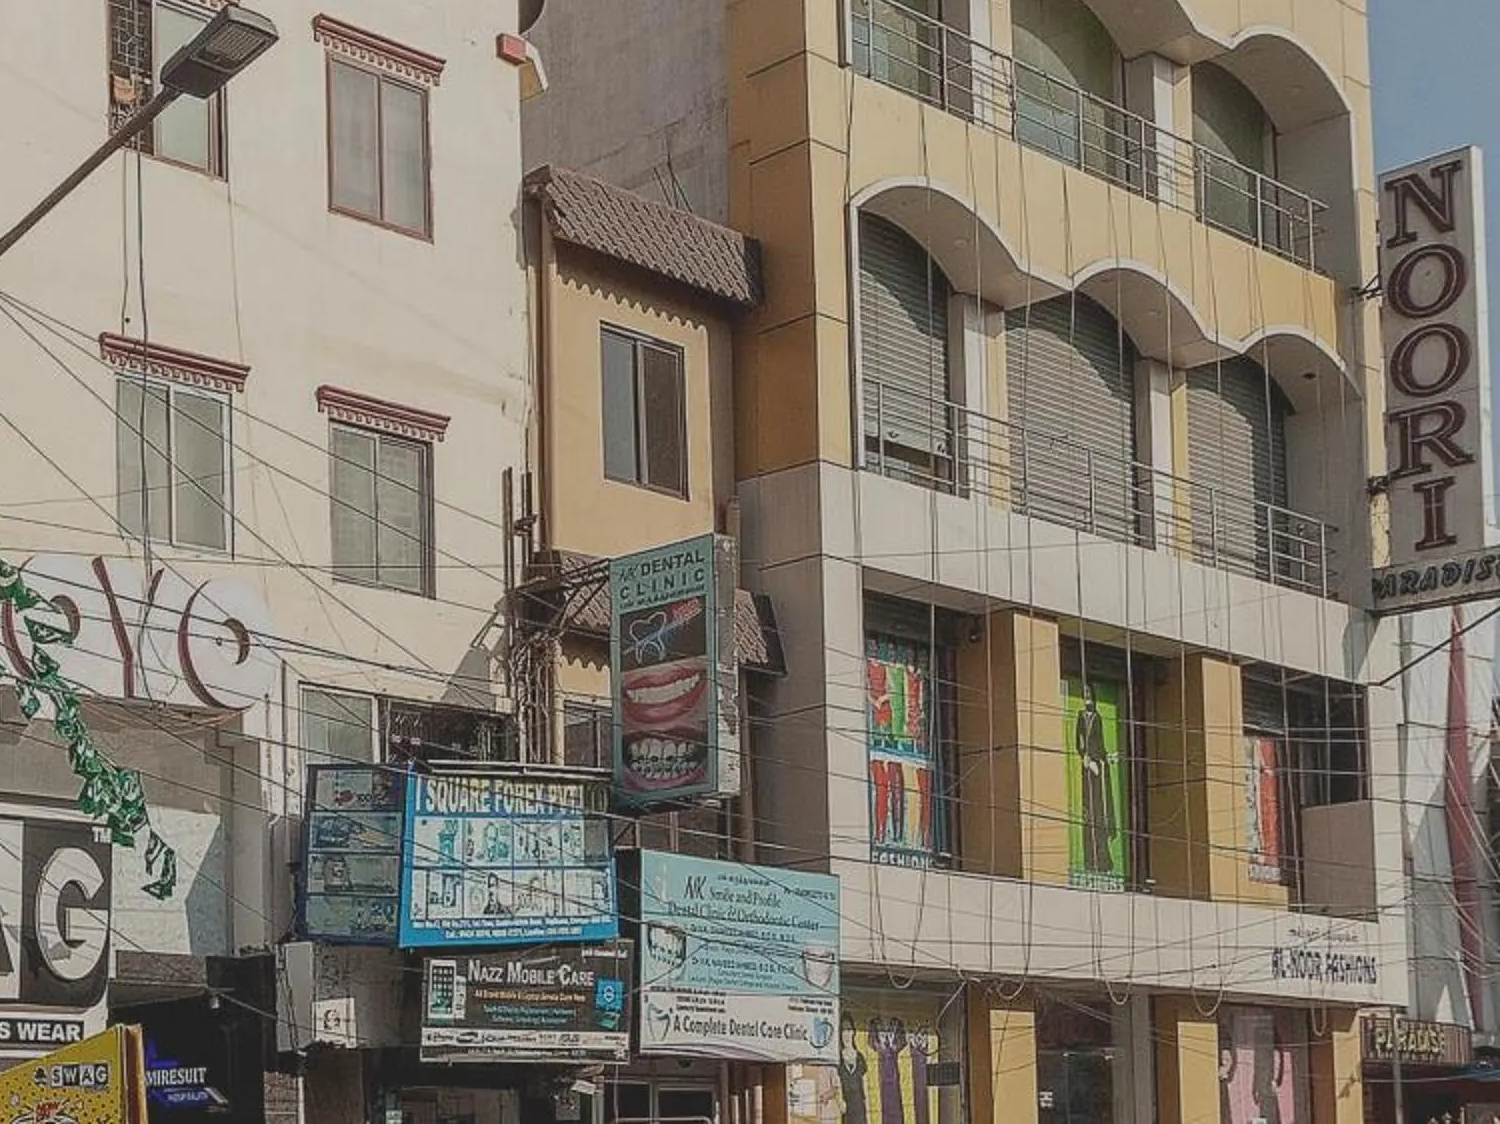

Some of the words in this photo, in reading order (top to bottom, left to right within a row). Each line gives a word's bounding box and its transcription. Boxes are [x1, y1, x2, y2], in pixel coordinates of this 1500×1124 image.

[1386, 160, 1474, 551] NOORI
[640, 549, 705, 577] DENTAL
[620, 568, 705, 599] CLINIC
[1373, 554, 1500, 601] ARADIS
[426, 776, 492, 813] SQUARE
[494, 779, 546, 815] FOREX
[507, 961, 555, 985] MOBILE
[558, 964, 595, 987] CARE
[18, 1023, 81, 1042] WEAR
[673, 1017, 681, 1032] A
[683, 1015, 727, 1036] Complete
[729, 1019, 758, 1037] Dental
[760, 1022, 782, 1039] Care
[784, 1023, 808, 1041] Clinic
[52, 1065, 108, 1086] SWAG
